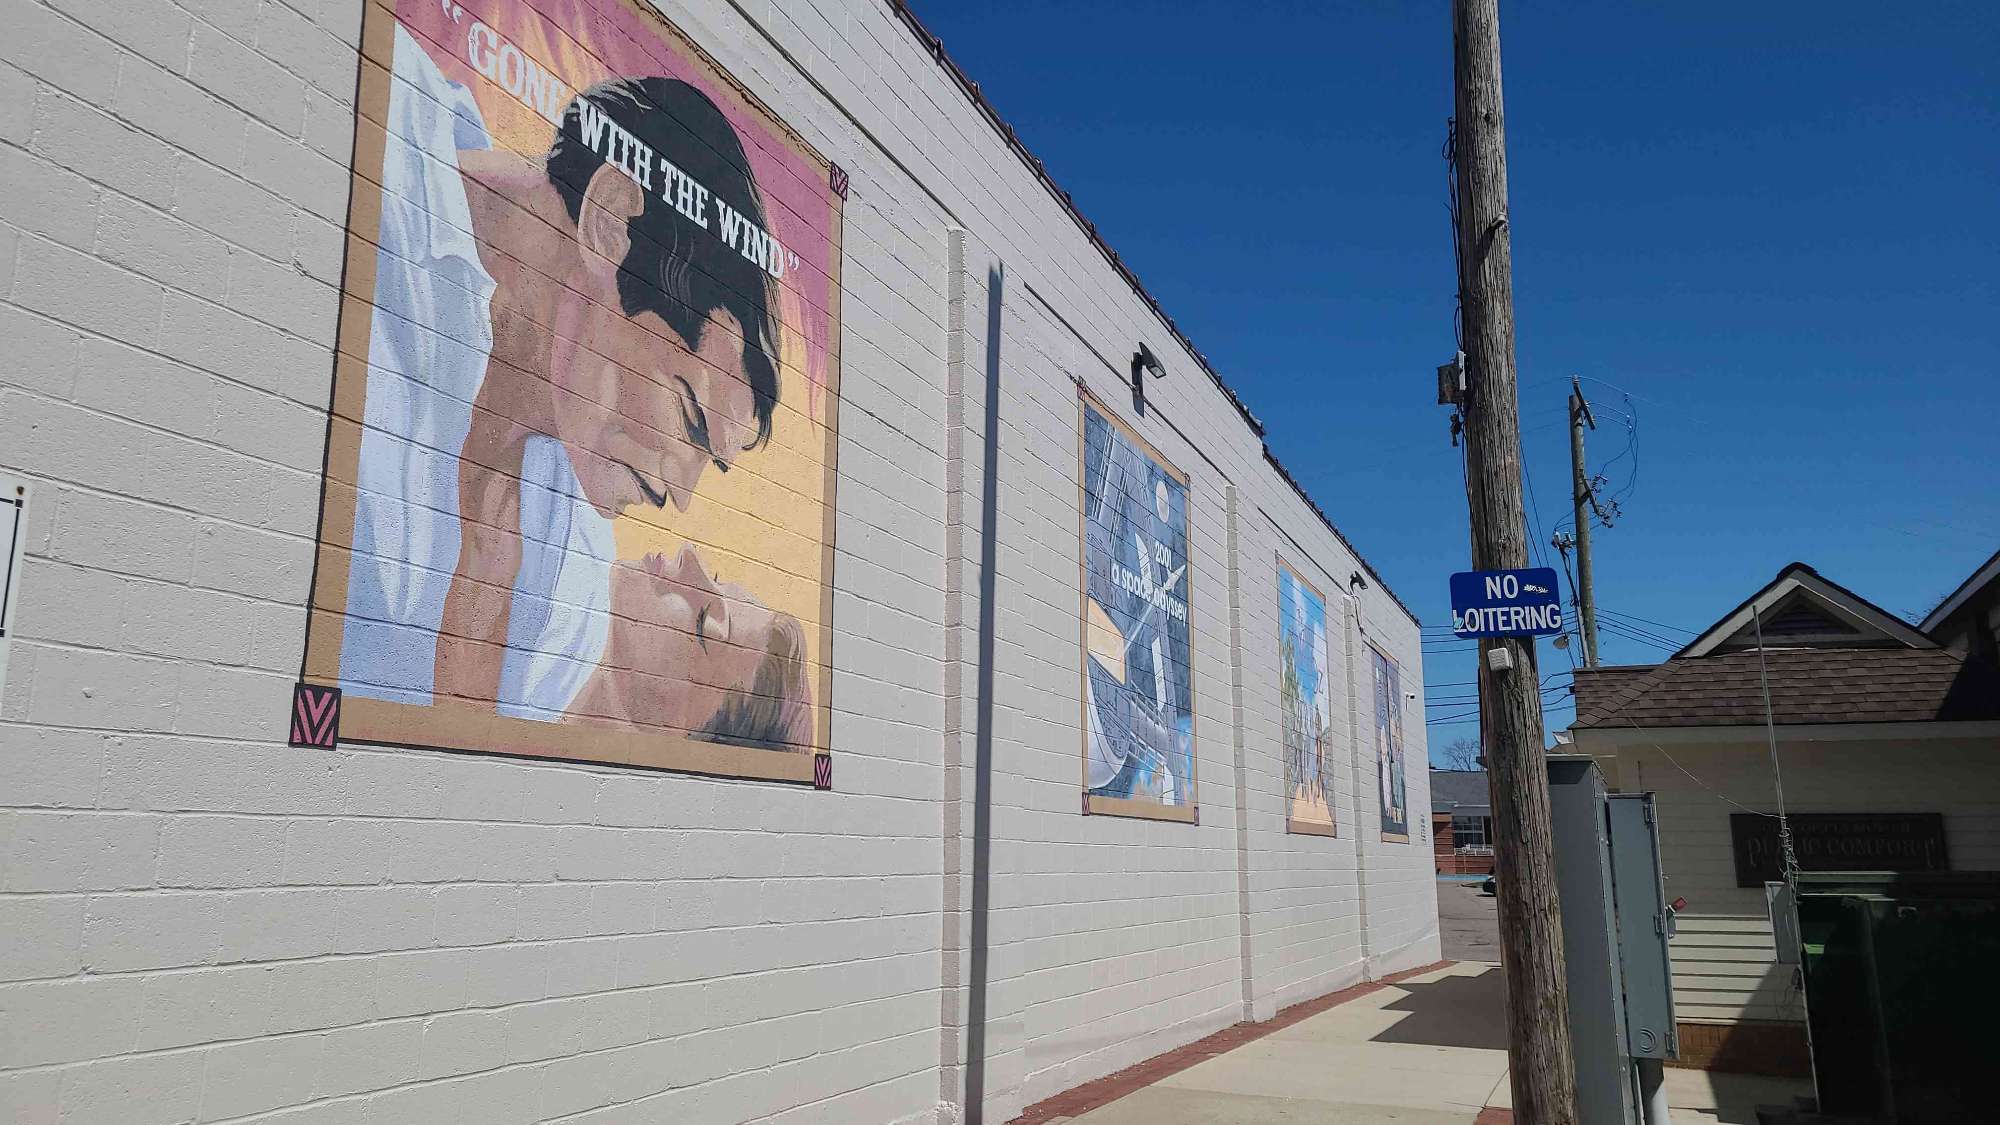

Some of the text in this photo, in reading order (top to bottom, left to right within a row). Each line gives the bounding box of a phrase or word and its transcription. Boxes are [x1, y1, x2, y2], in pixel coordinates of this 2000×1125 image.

[576, 96, 653, 191] WITH
[660, 158, 709, 230] THE
[1155, 541, 1172, 570] 2001
[1112, 563, 1120, 586] a
[1485, 574, 1519, 600] NO
[1453, 603, 1562, 633] LOITERING
